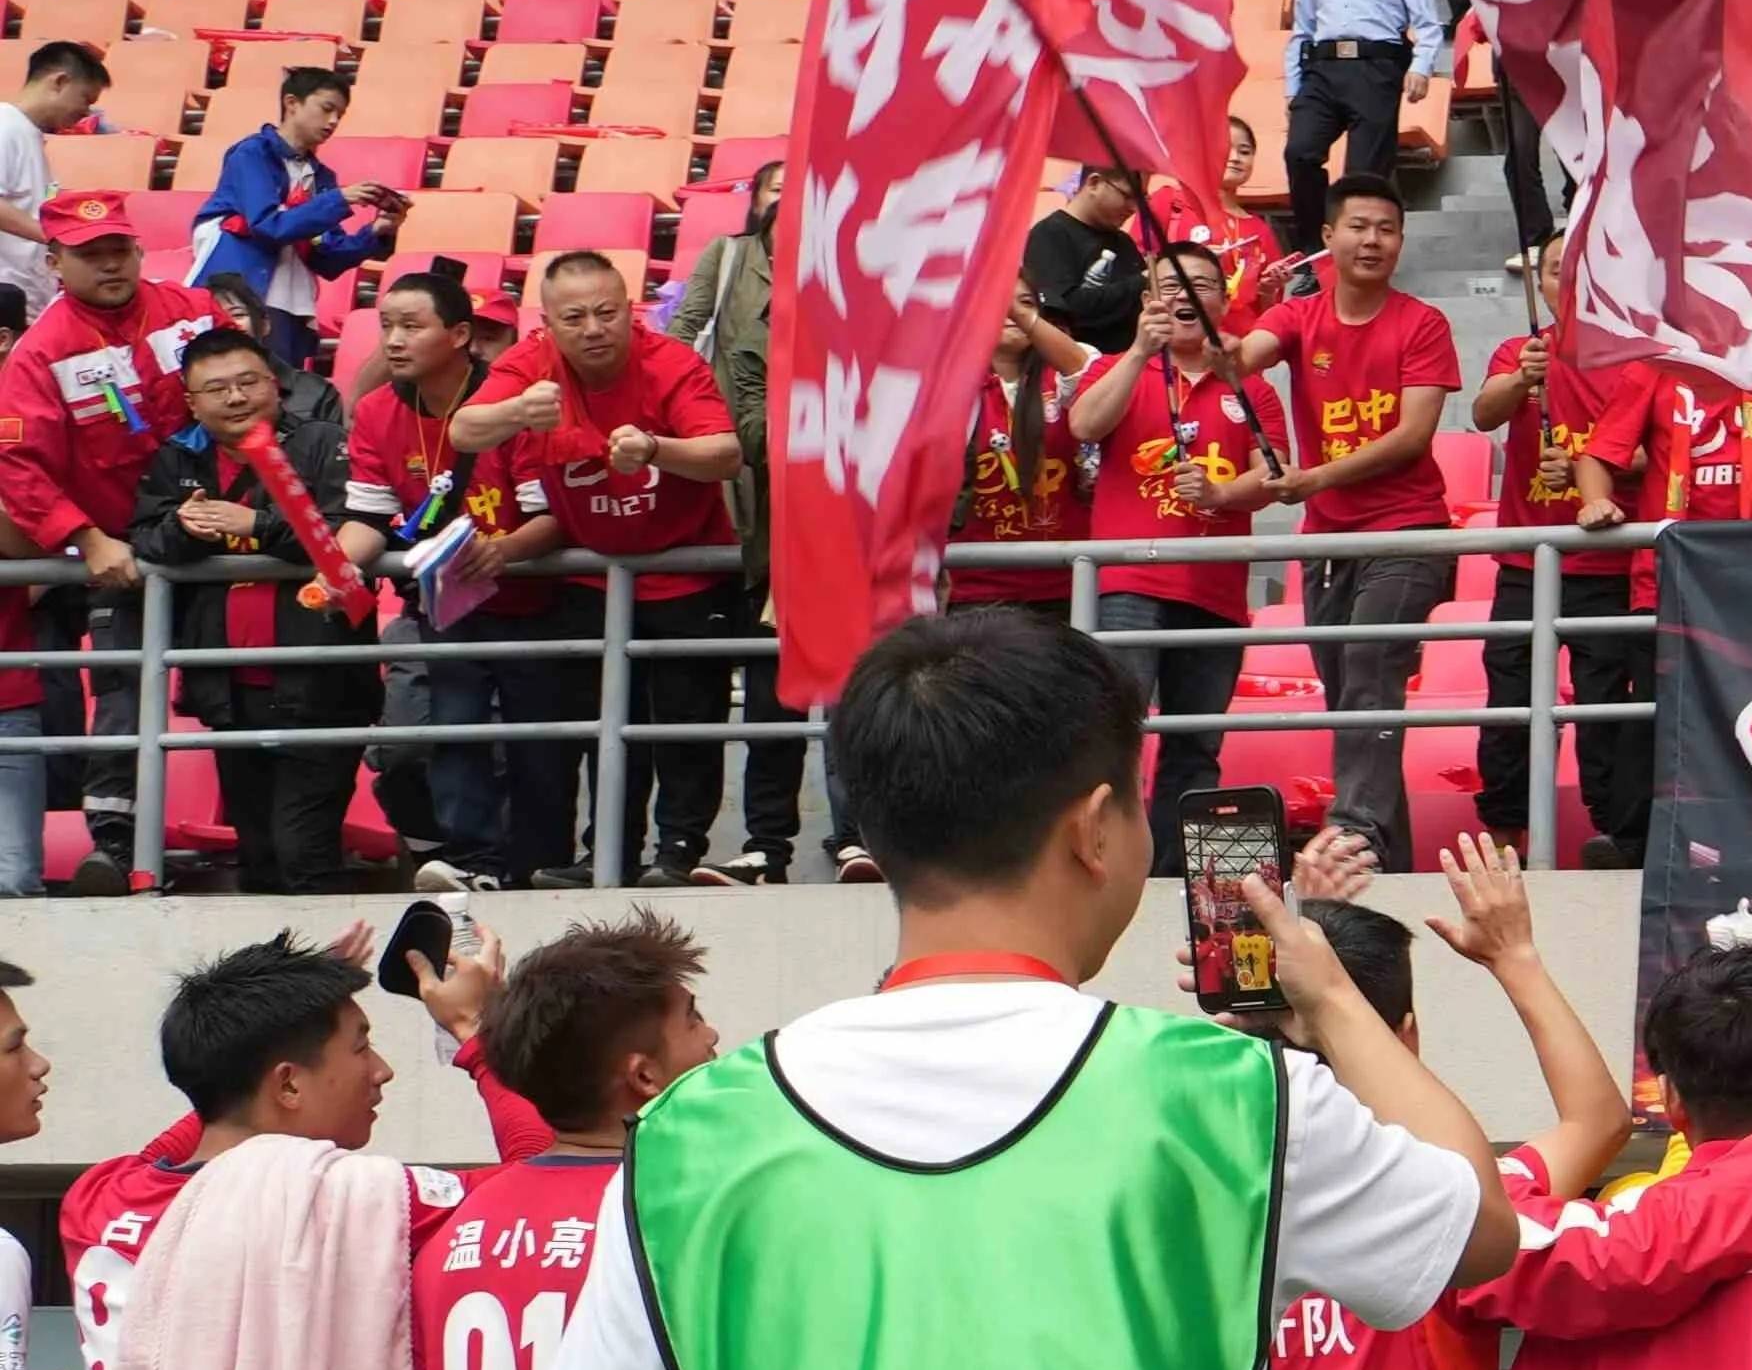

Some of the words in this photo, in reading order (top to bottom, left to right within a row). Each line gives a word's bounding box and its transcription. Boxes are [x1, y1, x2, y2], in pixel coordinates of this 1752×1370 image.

[1321, 388, 1396, 435] 巴中
[442, 1216, 597, 1274] 温小亮
